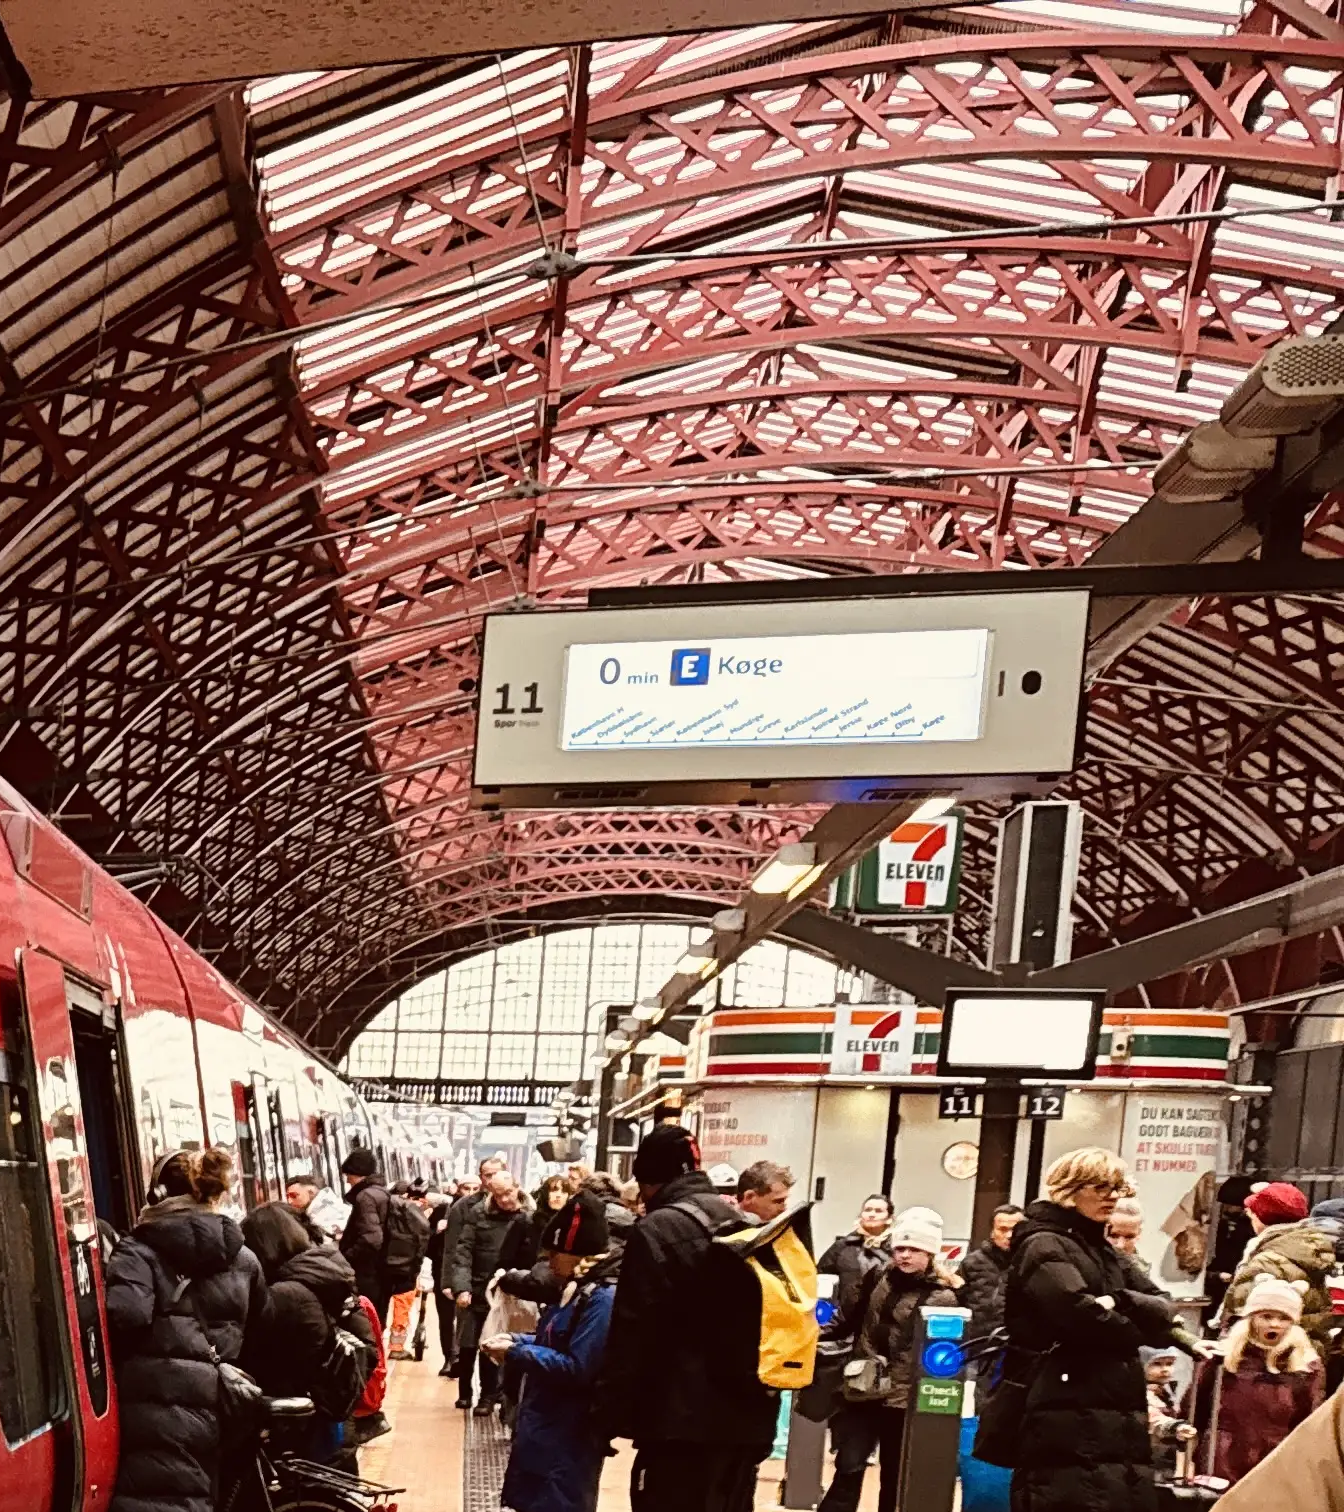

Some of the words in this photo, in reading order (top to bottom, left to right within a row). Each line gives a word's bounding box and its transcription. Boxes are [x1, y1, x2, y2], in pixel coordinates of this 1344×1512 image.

[599, 657, 621, 685] 0
[627, 671, 660, 685] min
[681, 655, 699, 678] E
[717, 655, 783, 677] Køge
[492, 682, 544, 715] 11
[943, 1096, 972, 1115] 11
[1032, 1097, 1061, 1115] 12
[1141, 1107, 1158, 1119] DU
[1160, 1107, 1183, 1120] KAN
[1139, 1124, 1170, 1137] GODT
[1137, 1141, 1152, 1154] AT
[1136, 1159, 1150, 1172] ET
[921, 1384, 960, 1397] Check
